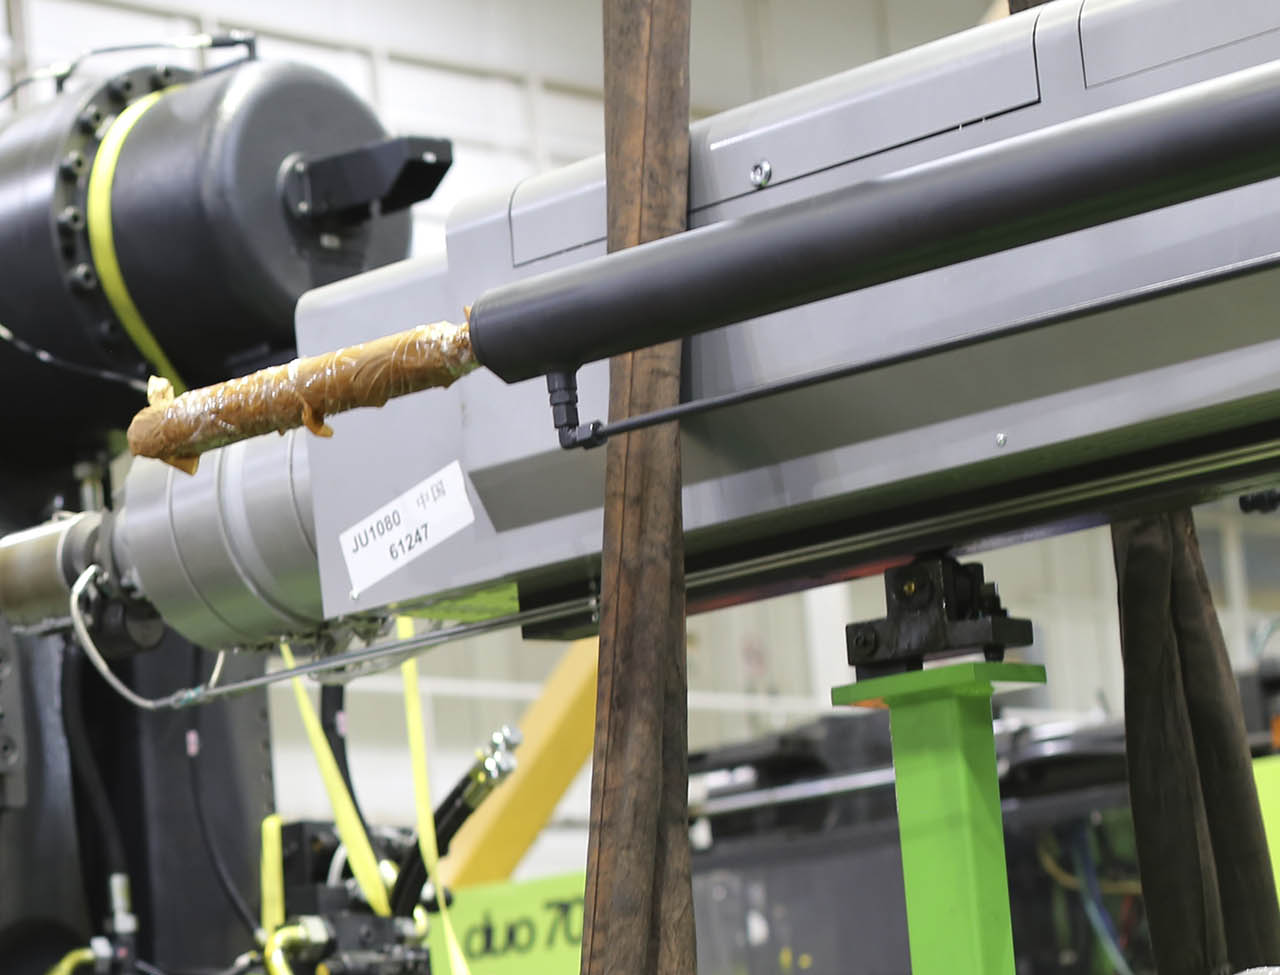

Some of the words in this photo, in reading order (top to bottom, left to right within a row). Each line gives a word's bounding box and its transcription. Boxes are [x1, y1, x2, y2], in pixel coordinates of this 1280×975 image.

[352, 509, 401, 553] JU1080
[389, 523, 430, 560] 61247
[464, 911, 537, 960] duo
